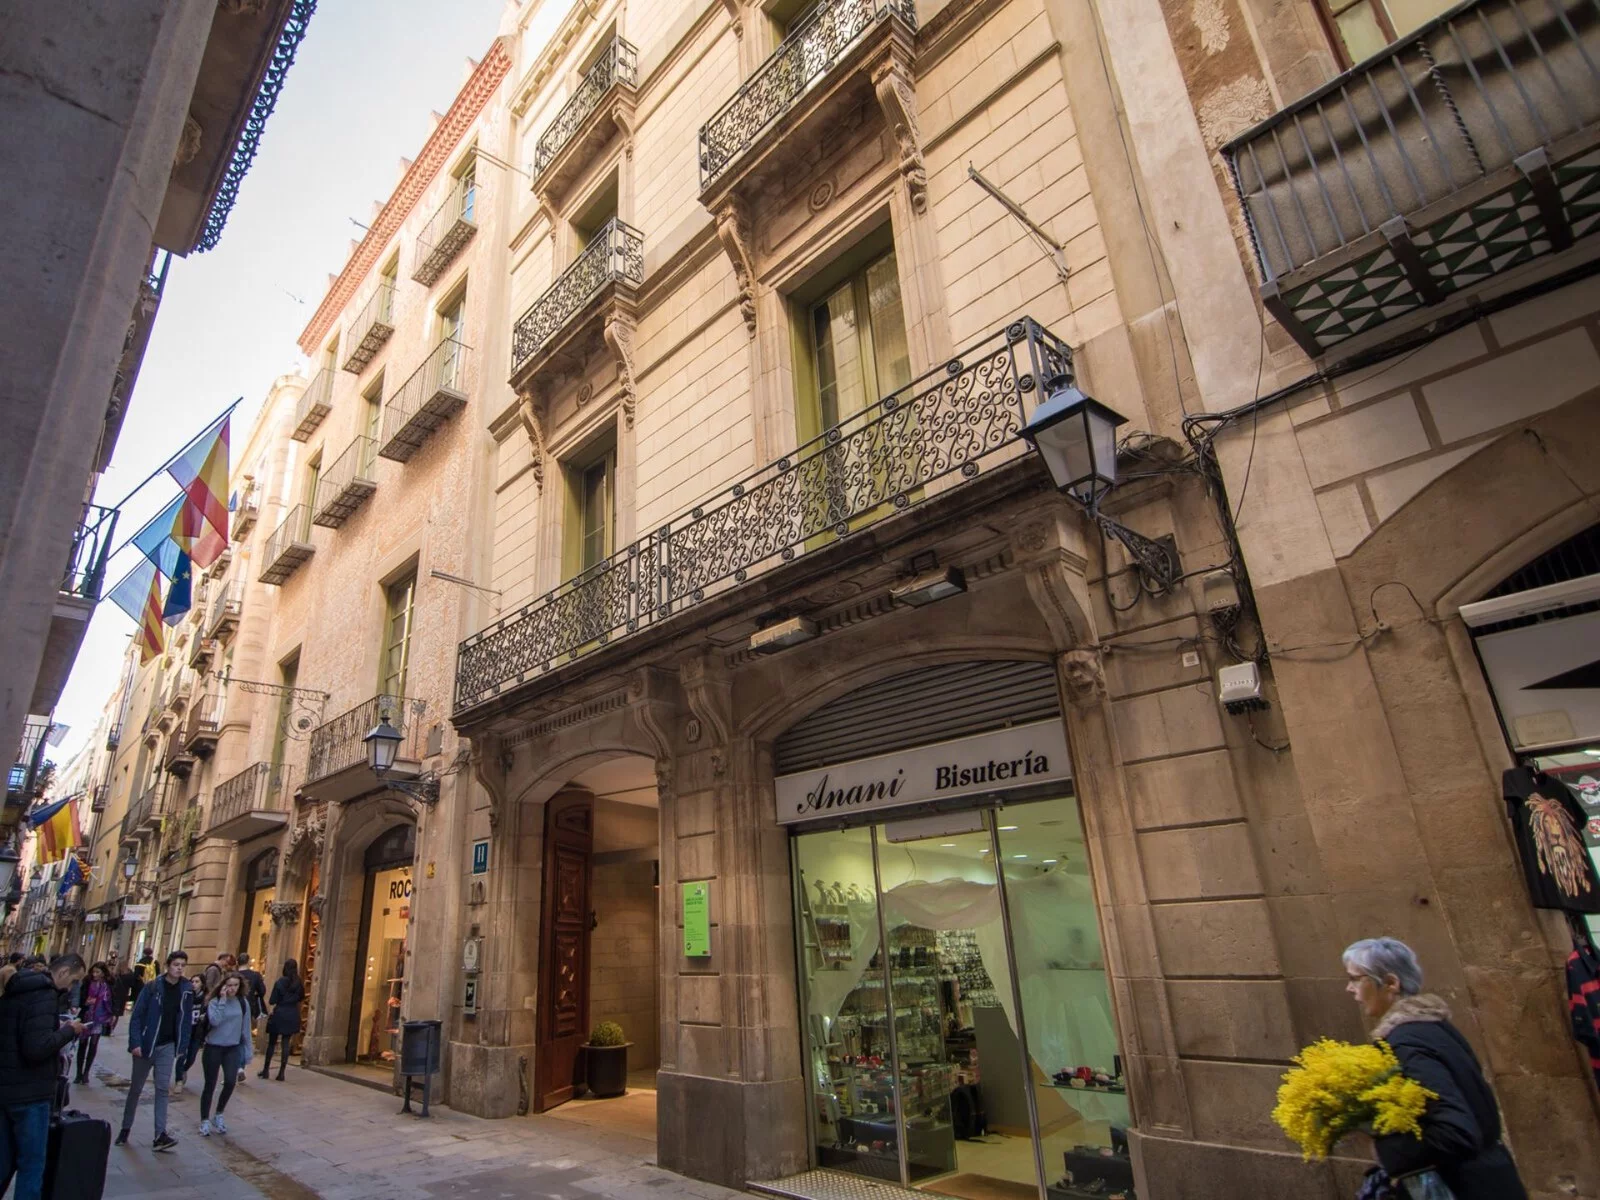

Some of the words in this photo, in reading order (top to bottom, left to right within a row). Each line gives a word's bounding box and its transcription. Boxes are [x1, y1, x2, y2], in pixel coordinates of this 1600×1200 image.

[796, 768, 907, 814] Anani
[935, 749, 1050, 791] Bisutería
[390, 879, 412, 899] ROC
